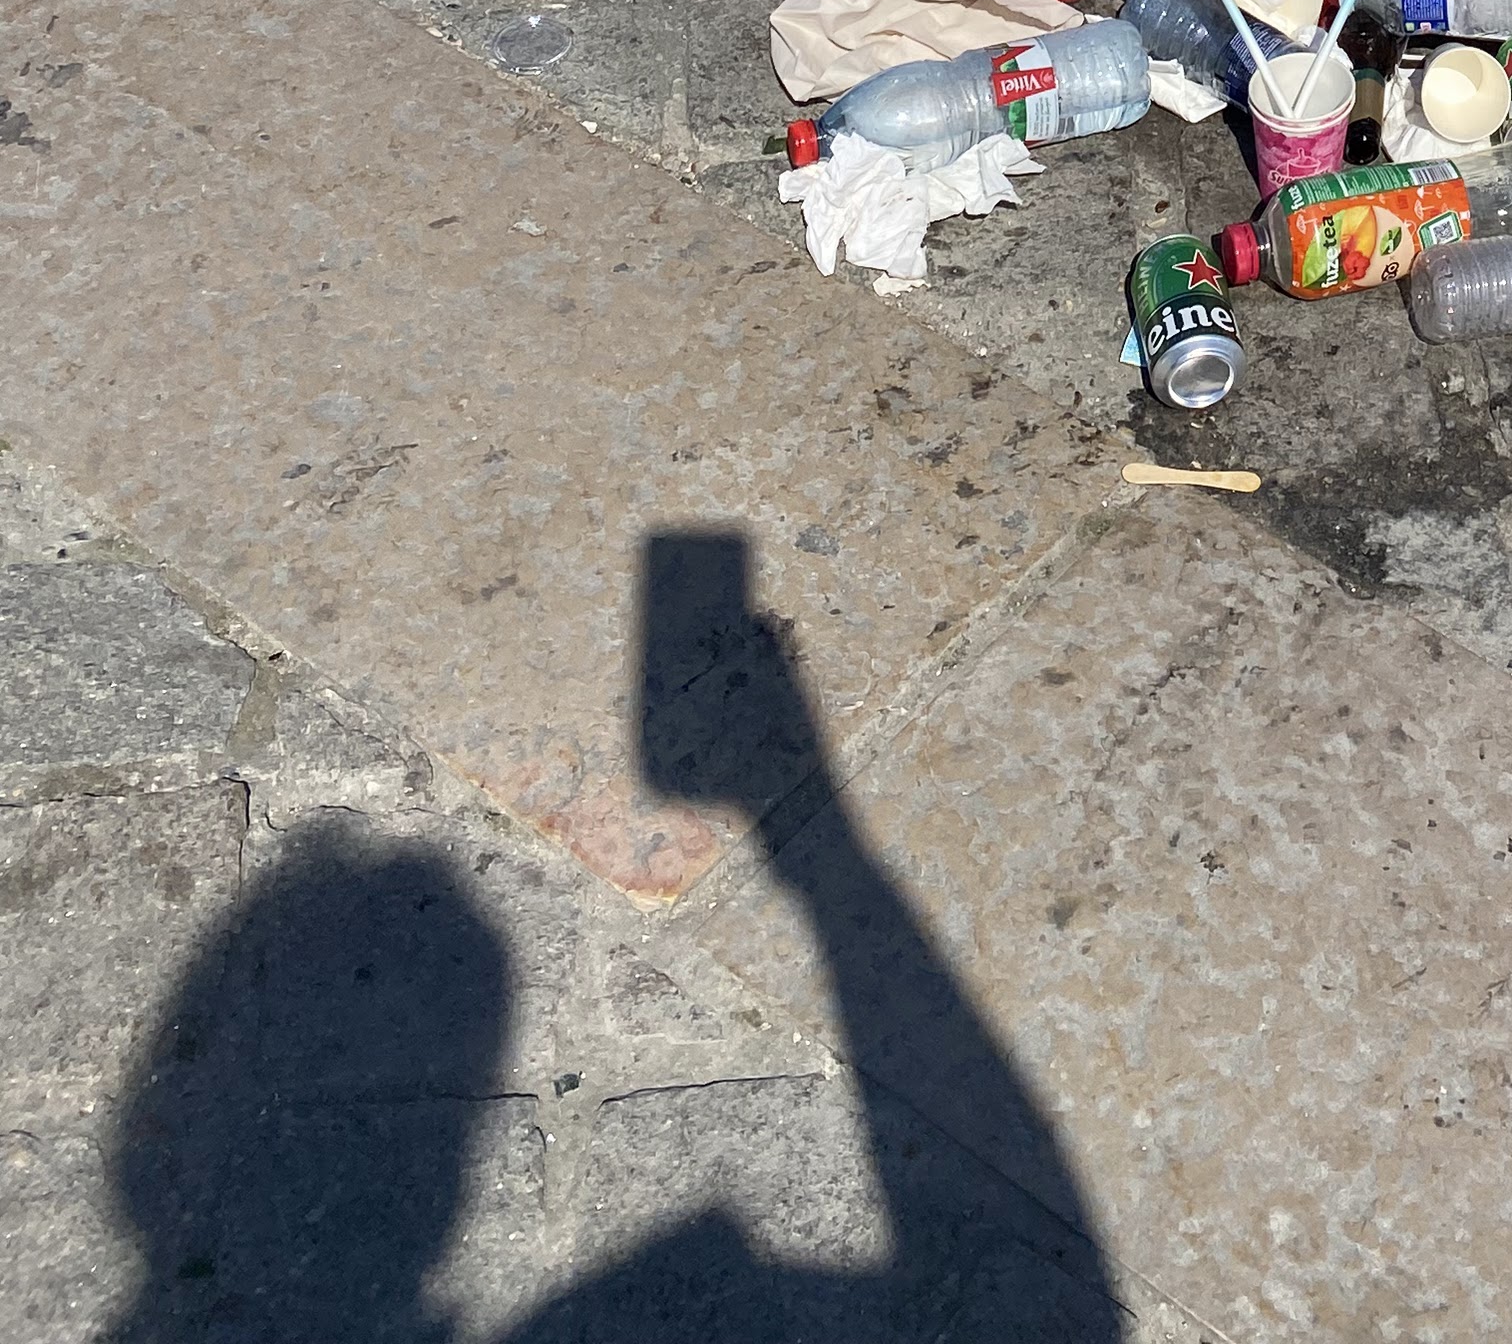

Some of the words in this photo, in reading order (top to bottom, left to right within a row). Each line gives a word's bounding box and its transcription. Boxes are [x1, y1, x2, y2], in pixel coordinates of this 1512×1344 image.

[1000, 73, 1042, 96] Vittel
[1321, 215, 1339, 289] fuzetea
[1147, 303, 1241, 356] eine
